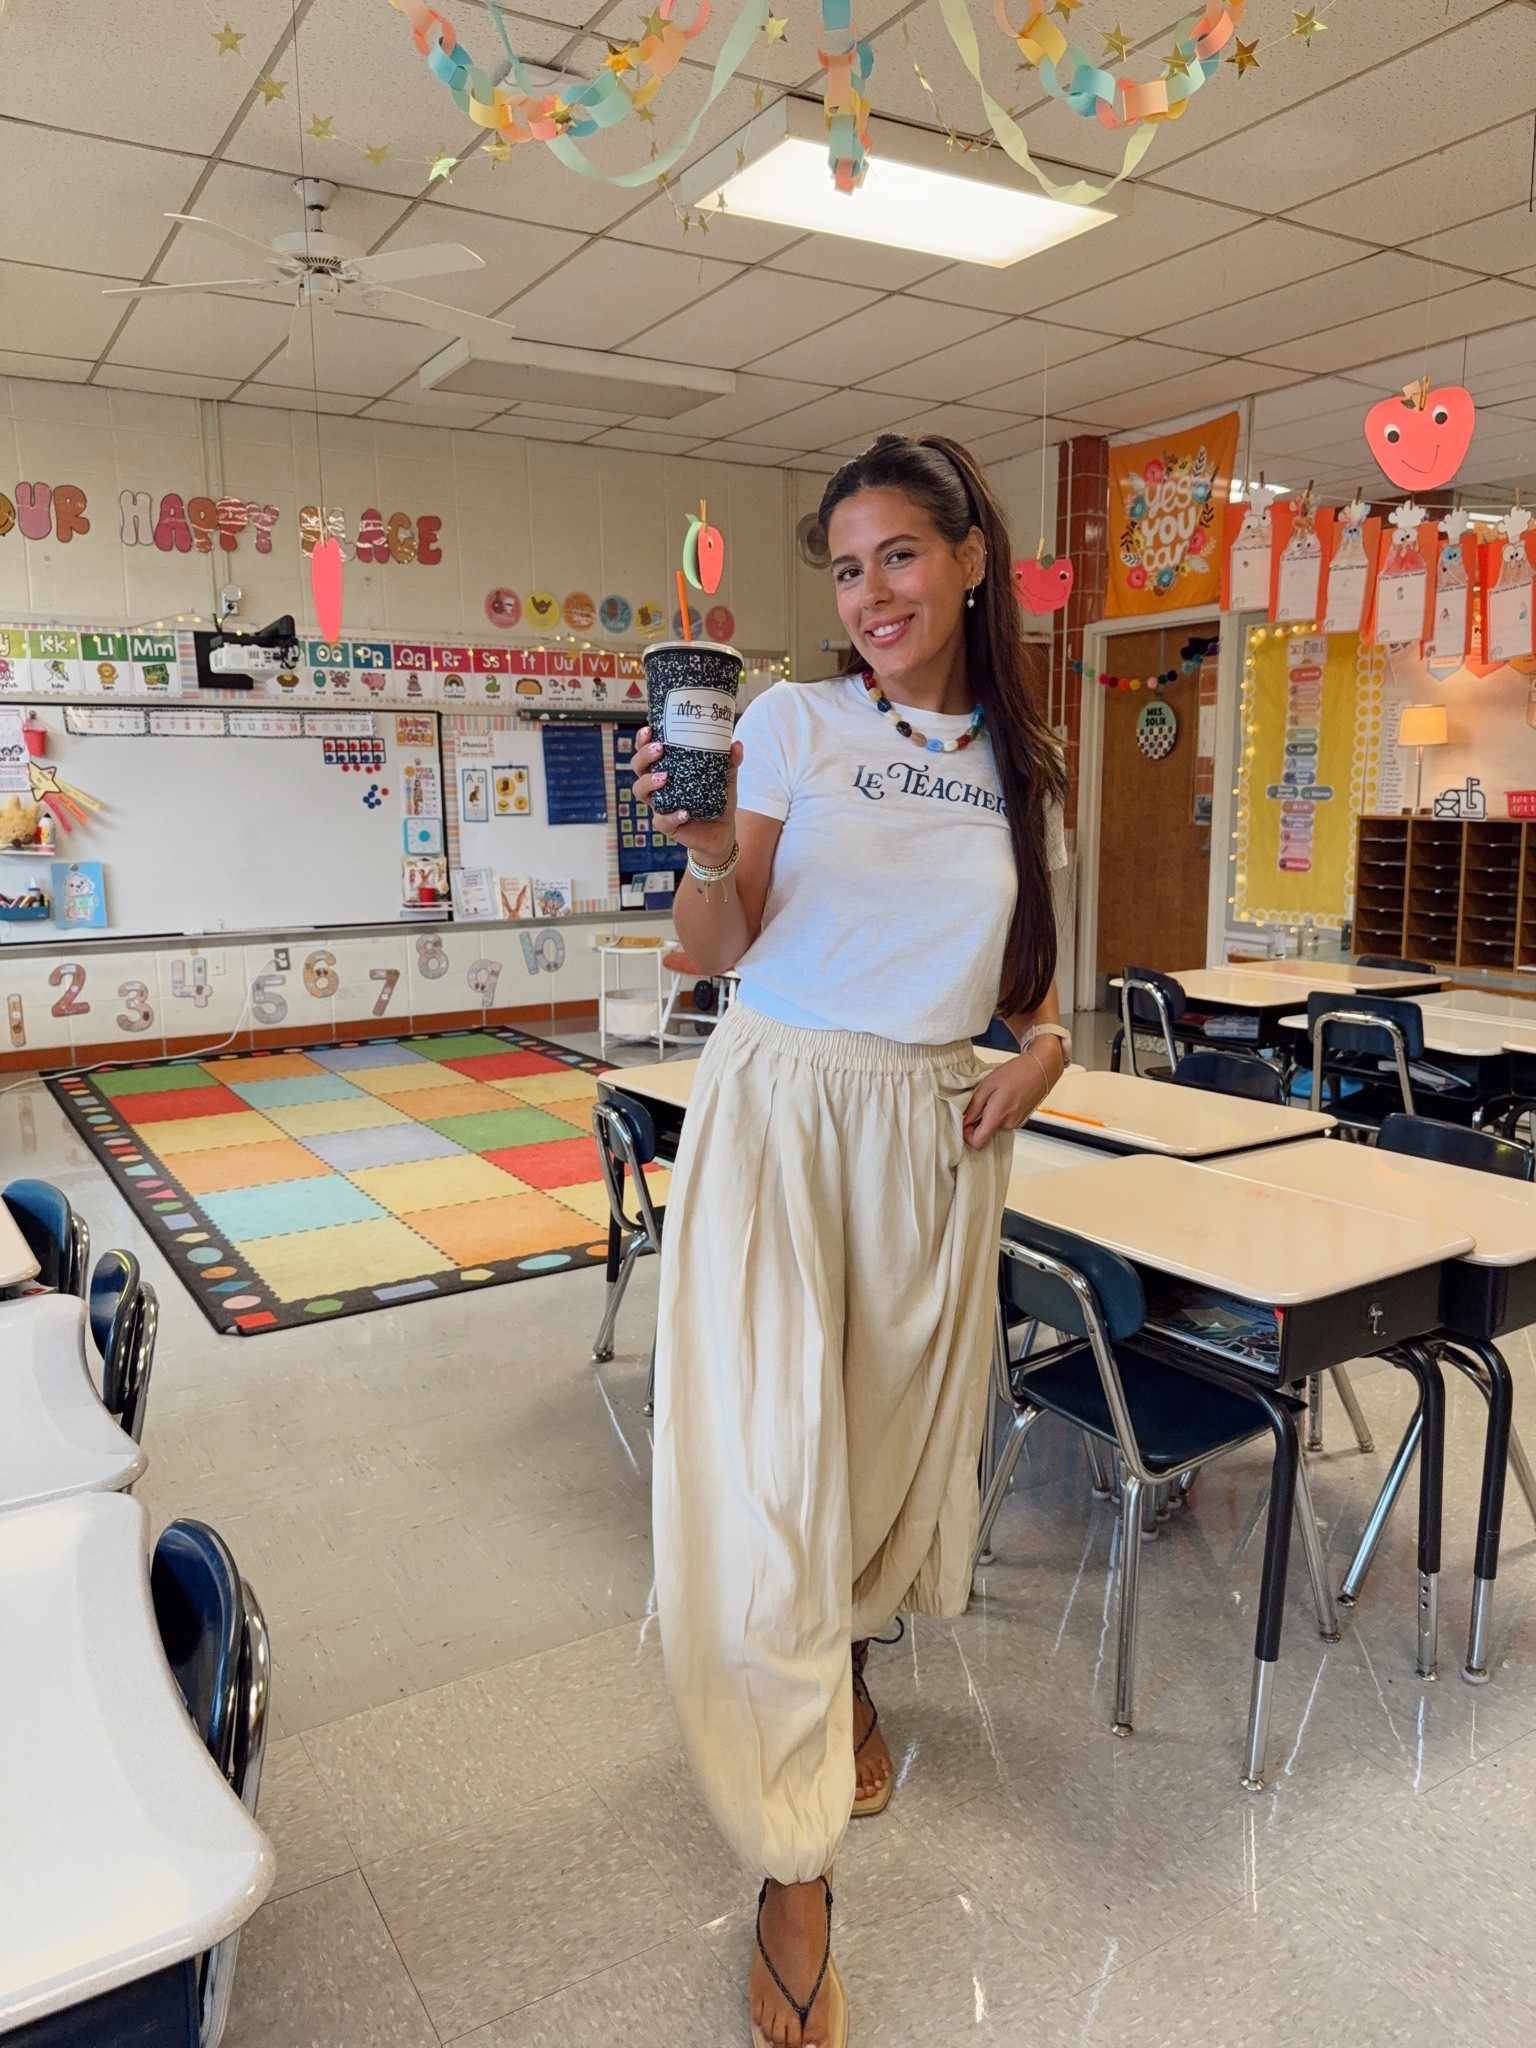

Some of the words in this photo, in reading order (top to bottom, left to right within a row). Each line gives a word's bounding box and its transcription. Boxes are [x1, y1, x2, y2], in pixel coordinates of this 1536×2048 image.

[119, 490, 280, 554] HAPPY
[1141, 507, 1196, 547] YOU
[39, 634, 69, 654] Kk
[133, 637, 174, 657] Mm
[359, 646, 385, 668] Pp
[400, 648, 426, 669] Qq
[441, 651, 462, 667] Rr
[482, 651, 500, 668] Ss
[520, 651, 536, 670] Tt
[553, 656, 574, 671] Uu
[588, 656, 609, 672] Vv
[678, 700, 706, 719] Mrs.
[1145, 717, 1167, 727] SOLIK
[1147, 707, 1164, 717] MRS.
[852, 765, 885, 800] LE
[416, 933, 449, 980] 8
[518, 928, 566, 975] 10
[171, 957, 212, 1008] 4
[303, 950, 339, 998] 6
[467, 958, 502, 1007] 9
[49, 963, 90, 1017] 2
[252, 975, 288, 1024] 5
[369, 968, 400, 1016] 7
[117, 980, 154, 1032] 3
